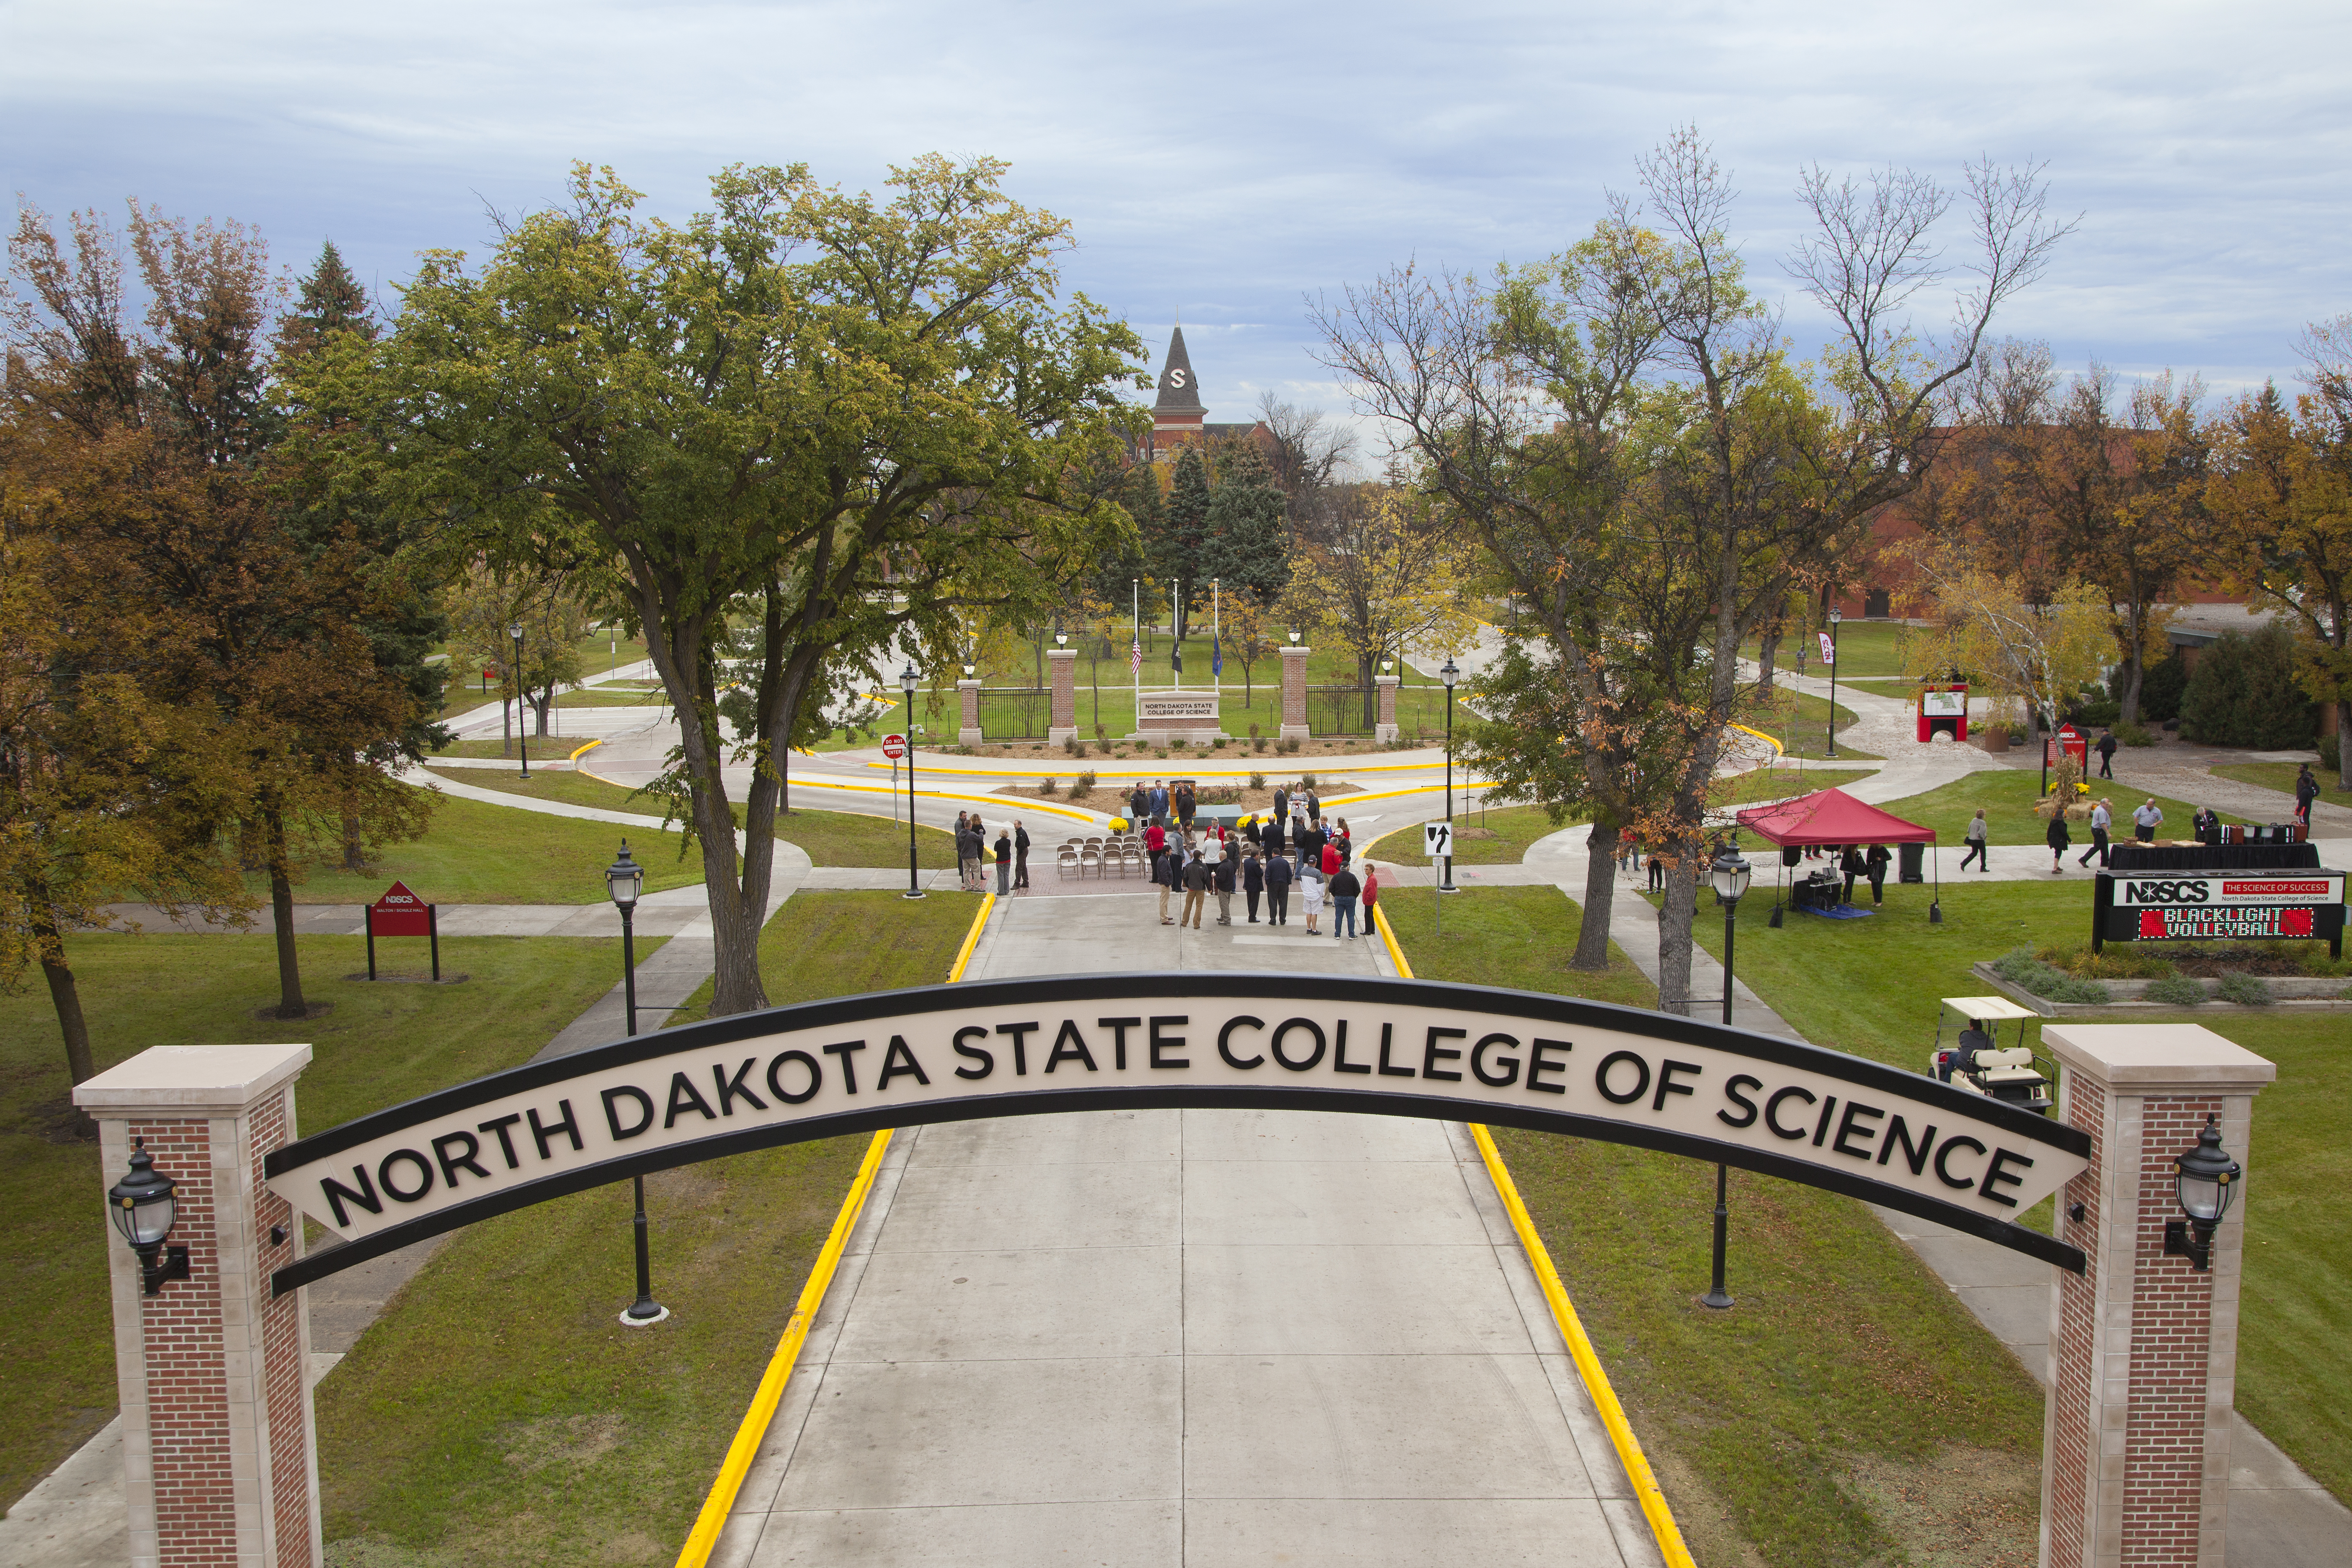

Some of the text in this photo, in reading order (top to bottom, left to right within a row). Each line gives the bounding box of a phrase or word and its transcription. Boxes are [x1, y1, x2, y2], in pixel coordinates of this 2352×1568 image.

[1171, 369, 1185, 388] S
[2126, 881, 2209, 903] NDSCS
[2164, 908, 2283, 922] BLACKLIGHT
[2167, 922, 2283, 936] VOLLEYBALL
[319, 1014, 2034, 1228] NORTH DAKOTA STATE COLLEGE OF SCIENCE
